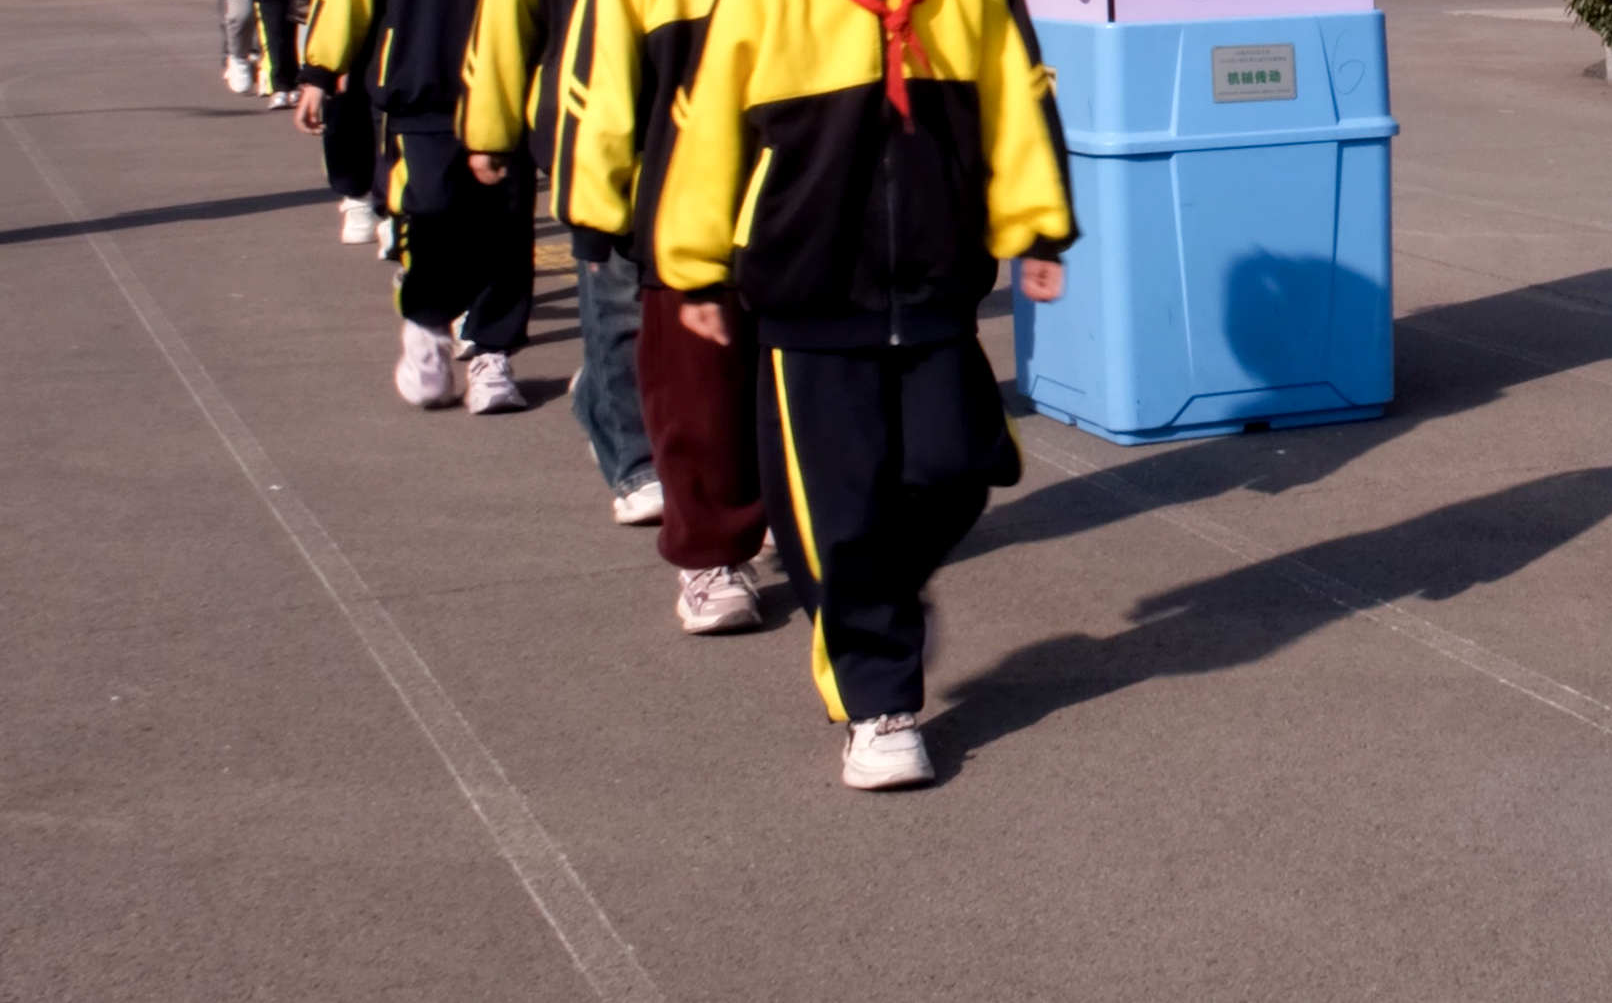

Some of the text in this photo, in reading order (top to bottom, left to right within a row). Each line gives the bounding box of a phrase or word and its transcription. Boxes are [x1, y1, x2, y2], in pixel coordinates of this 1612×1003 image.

[1227, 69, 1282, 85] 机械传动
[1332, 30, 1366, 95] 6
